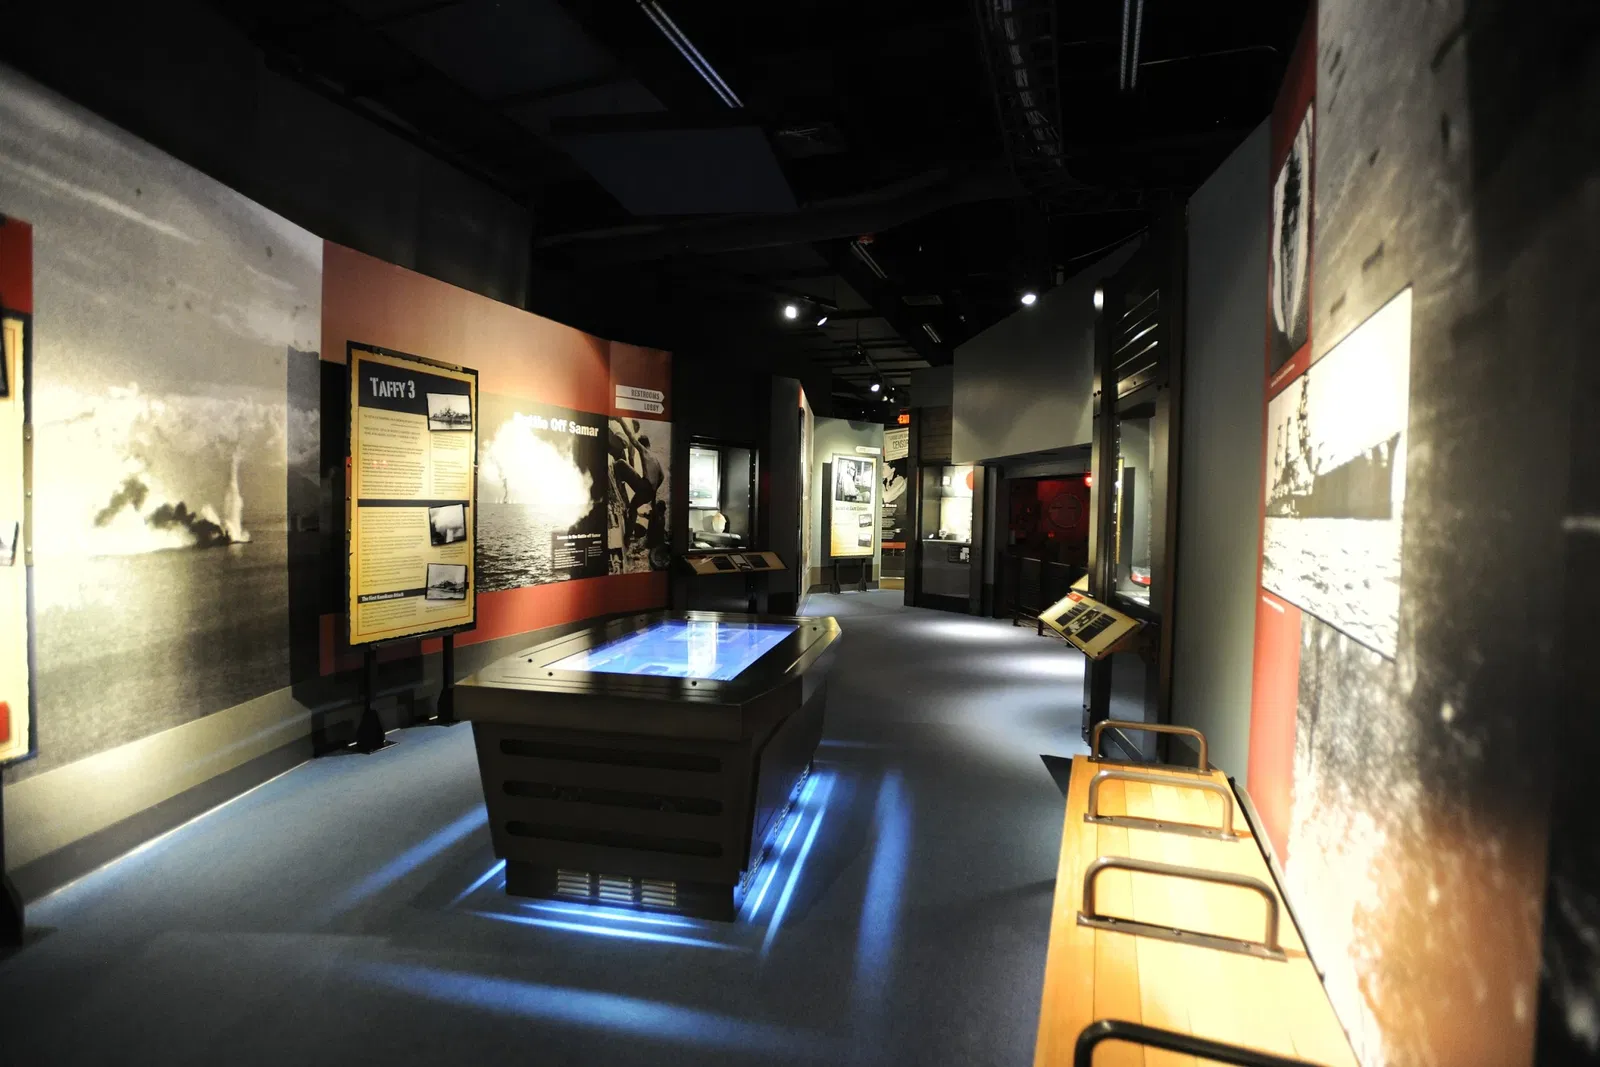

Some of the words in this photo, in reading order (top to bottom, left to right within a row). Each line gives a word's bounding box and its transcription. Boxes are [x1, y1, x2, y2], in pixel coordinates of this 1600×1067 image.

[408, 380, 416, 399] 3
[631, 389, 660, 400] RESTROOMS
[644, 403, 660, 412] LOBBY
[550, 418, 566, 433] Off
[568, 421, 599, 437] Samar
